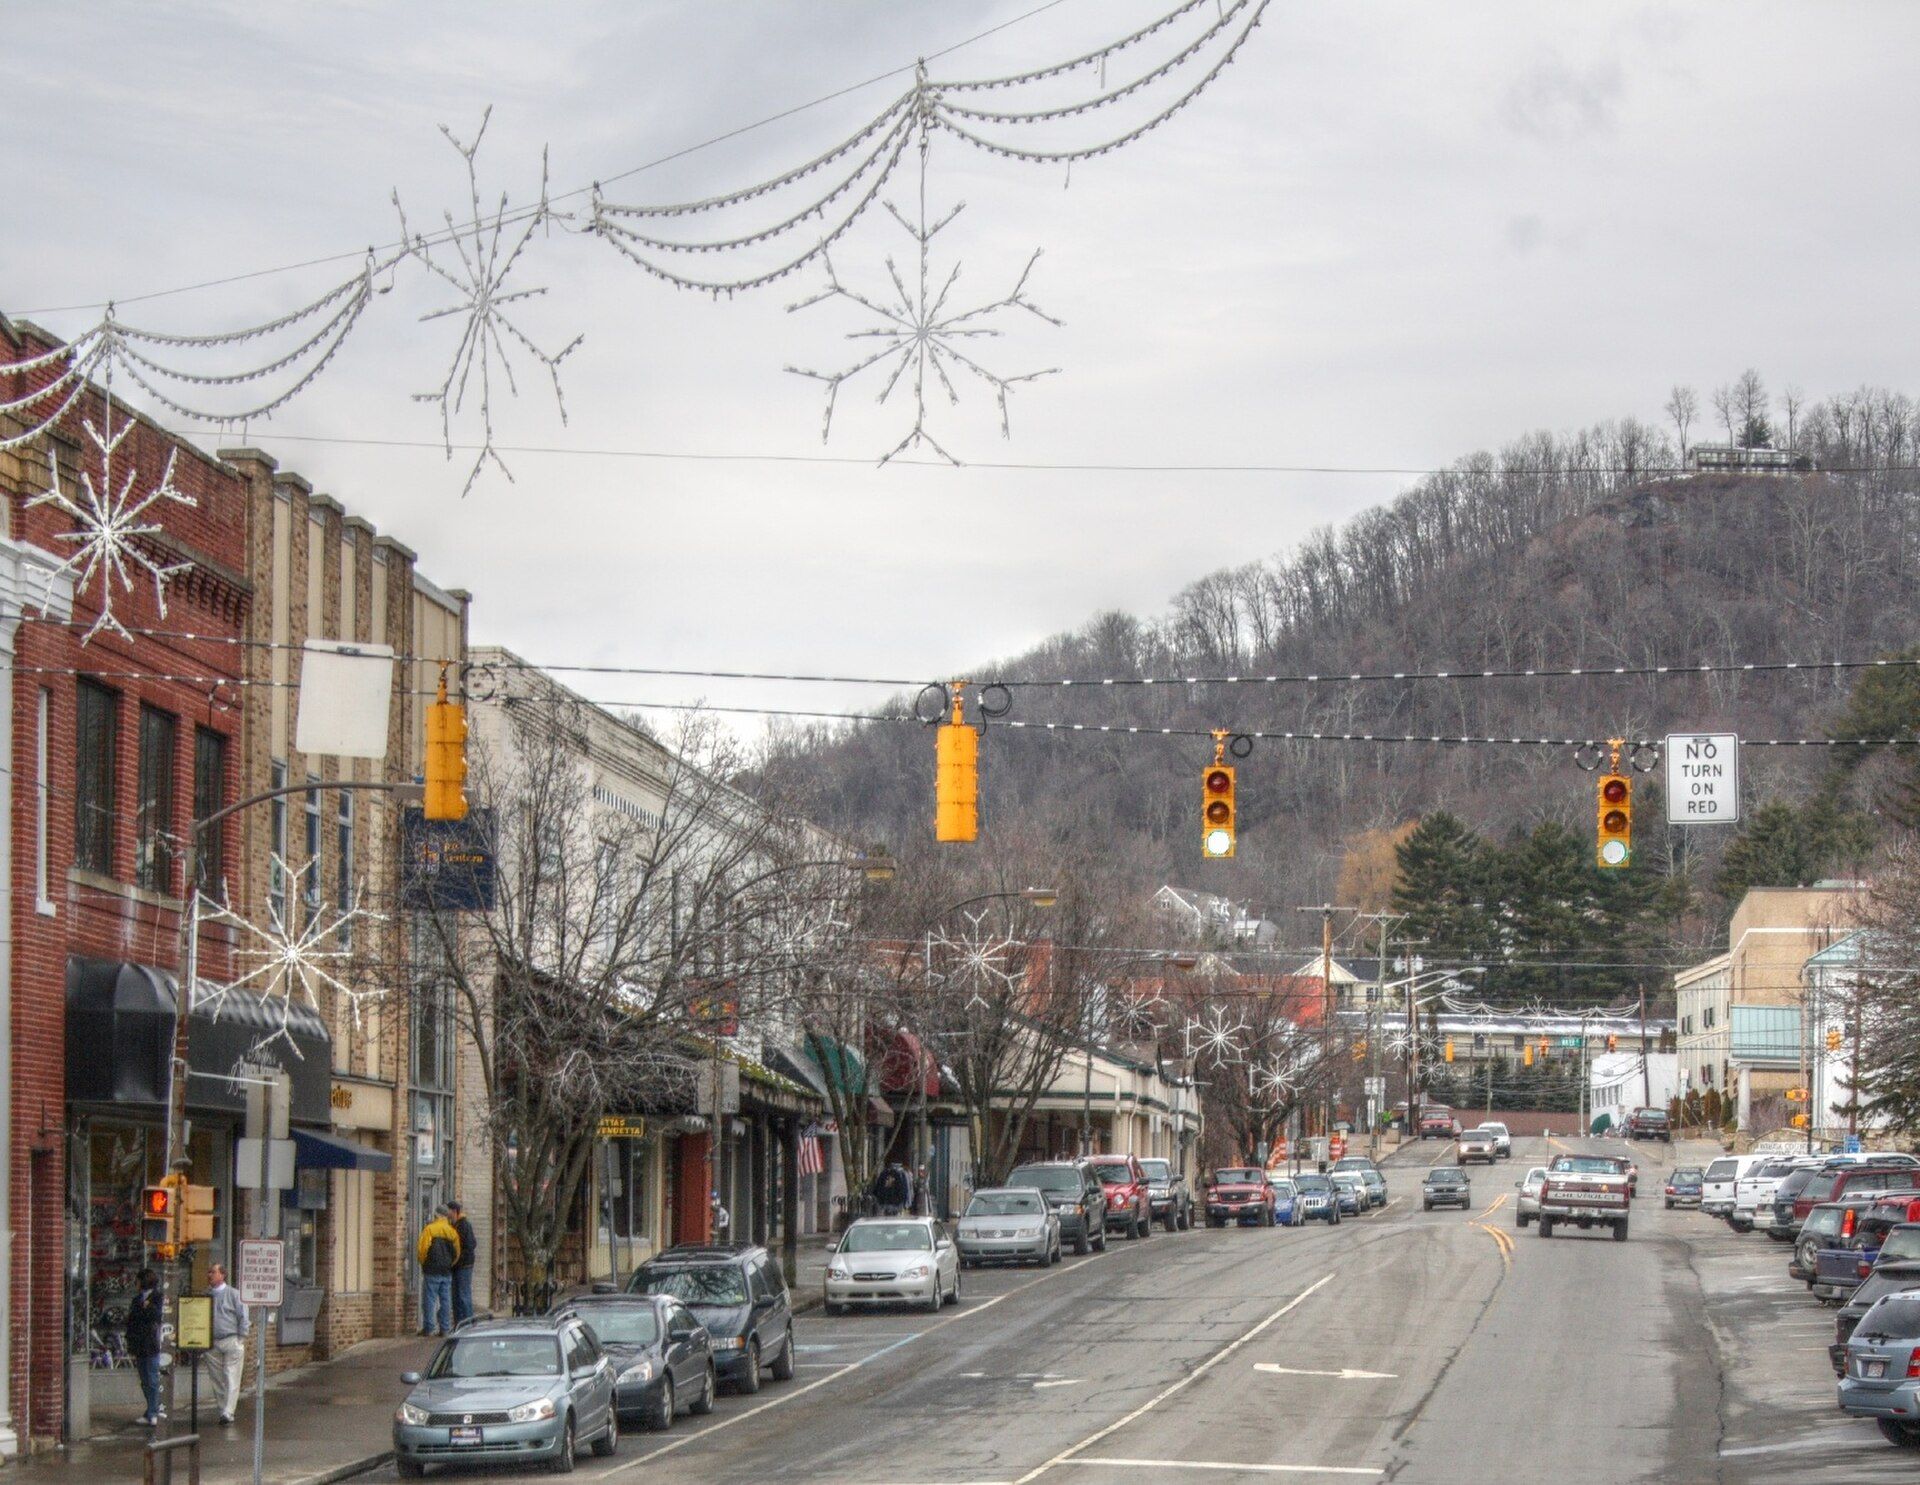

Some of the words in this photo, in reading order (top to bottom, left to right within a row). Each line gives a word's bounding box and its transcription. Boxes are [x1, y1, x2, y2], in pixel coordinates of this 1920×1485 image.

[1686, 743, 1717, 759] NO
[1681, 764, 1722, 777] TURN
[1691, 782, 1714, 796] ON
[1687, 800, 1718, 814] RED
[1554, 1192, 1616, 1201] CHEVROLET
